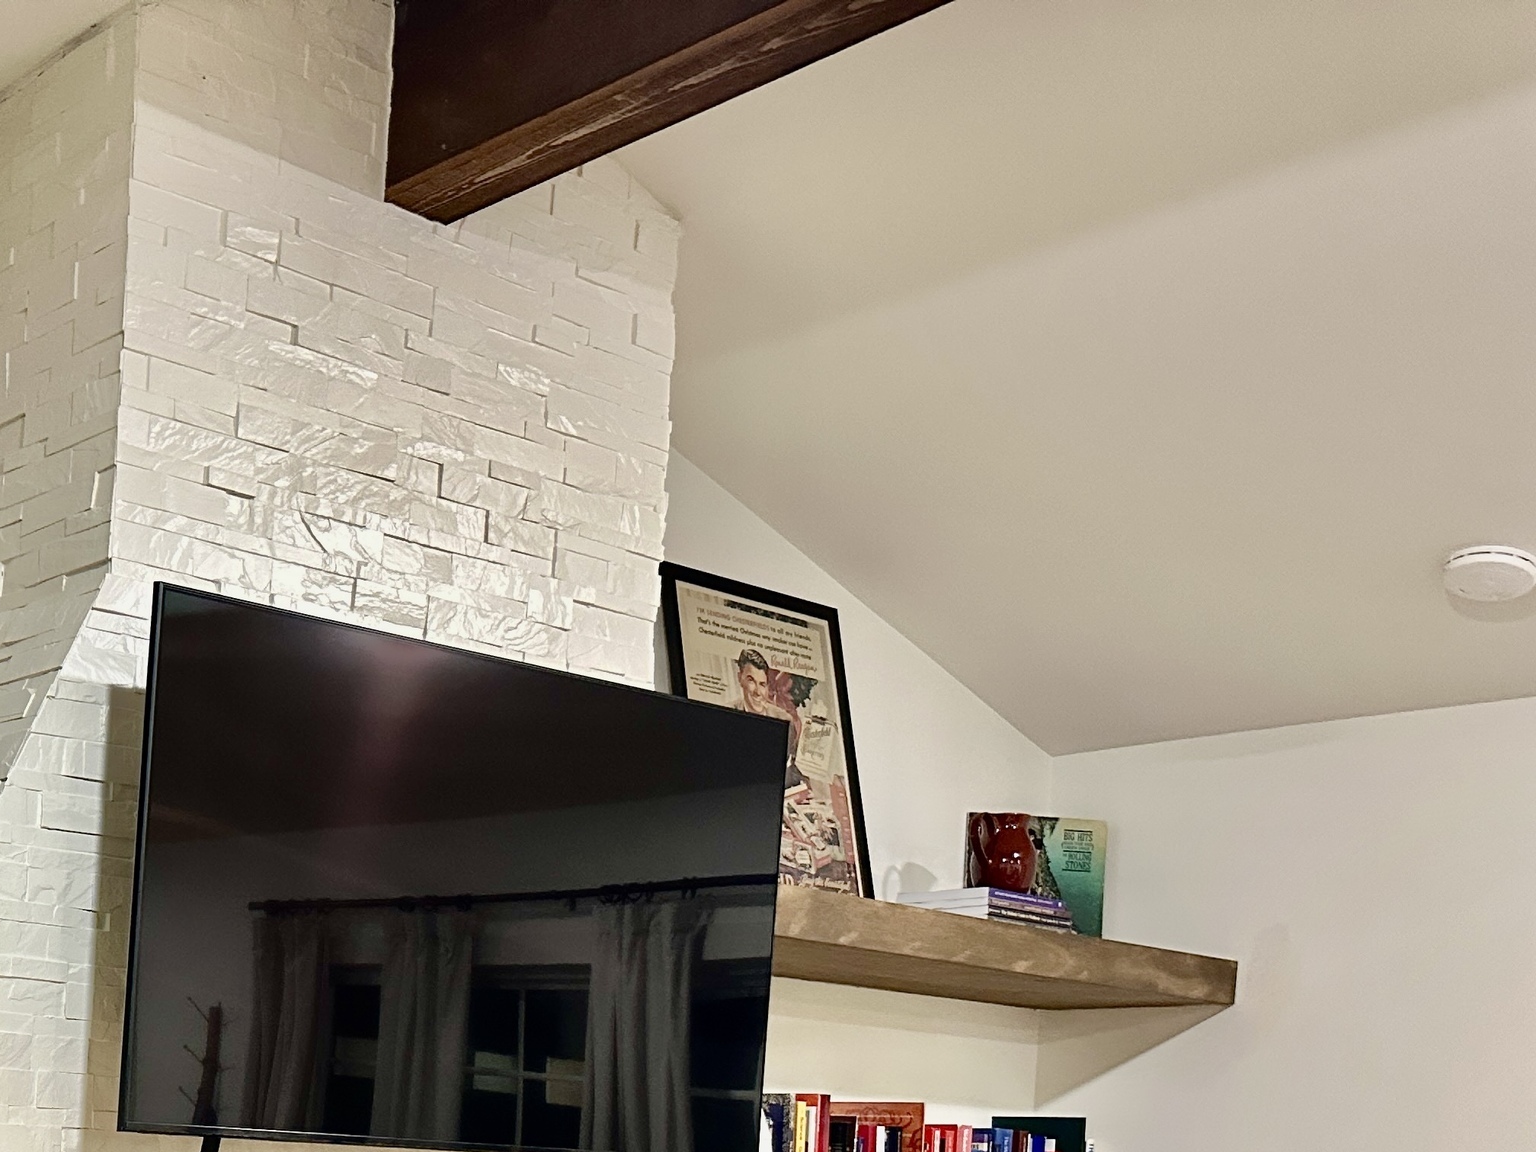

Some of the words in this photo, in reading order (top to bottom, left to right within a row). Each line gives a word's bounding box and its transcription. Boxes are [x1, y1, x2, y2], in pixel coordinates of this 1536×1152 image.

[1064, 832, 1074, 841] BIG
[1078, 833, 1093, 841] HITS
[1068, 852, 1091, 861] ROLLING
[1065, 861, 1091, 869] STONES
